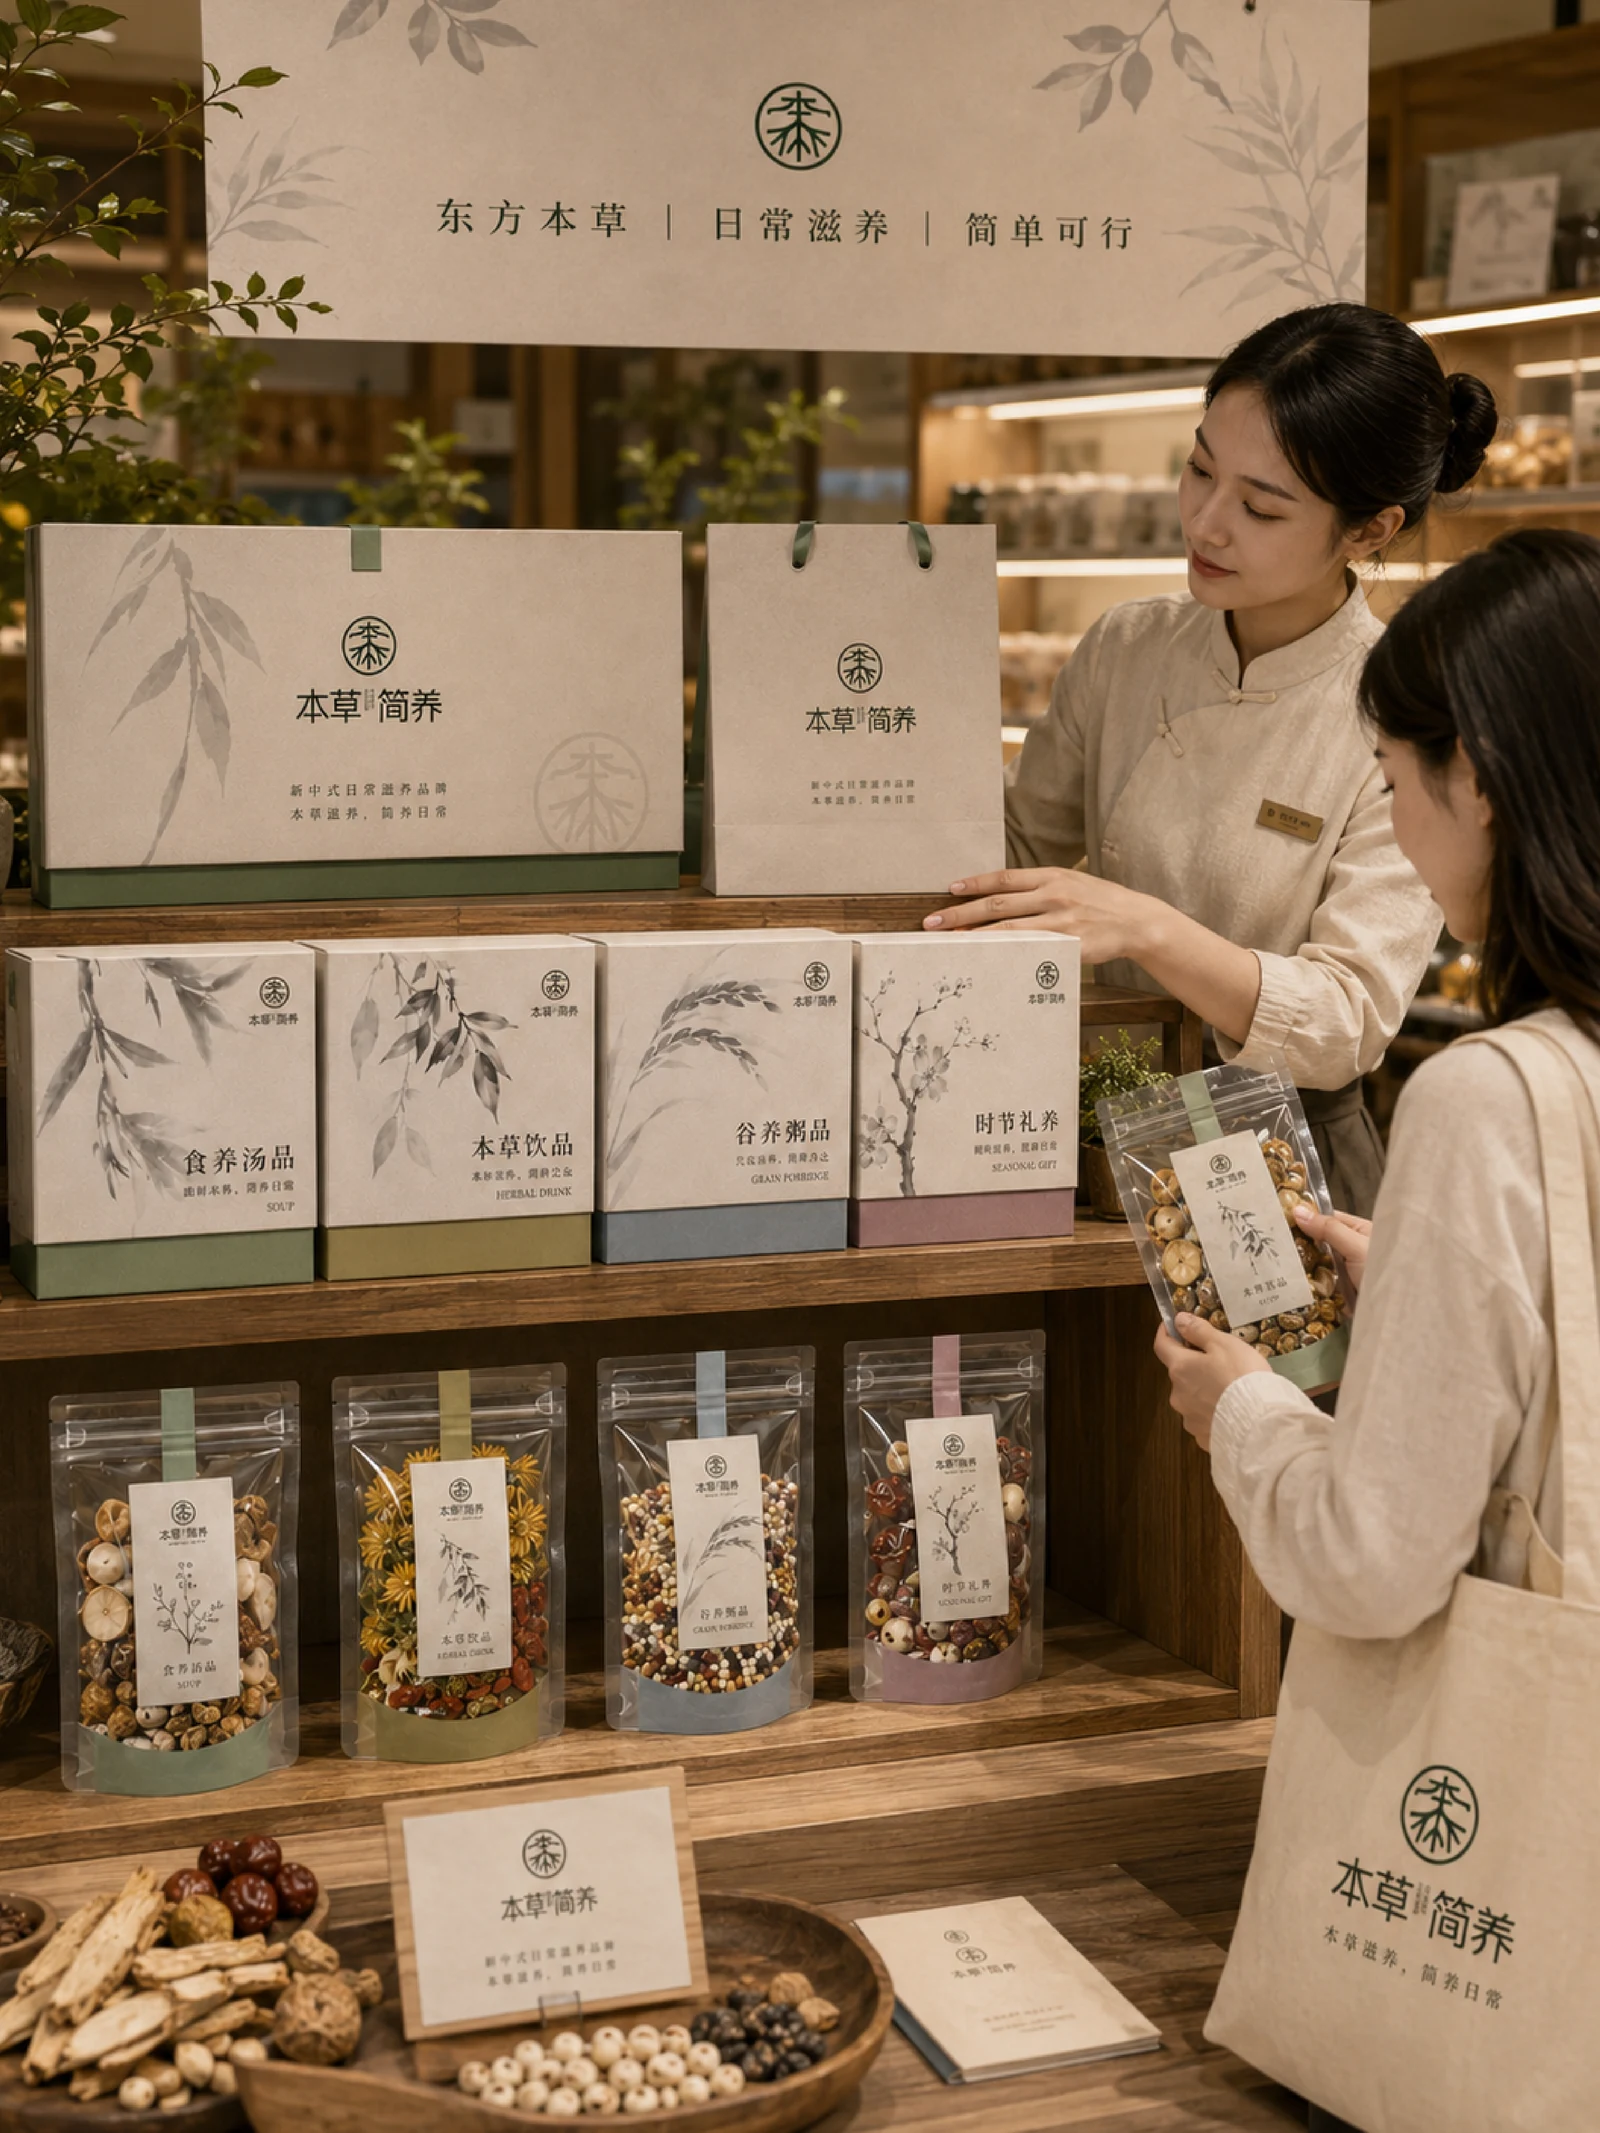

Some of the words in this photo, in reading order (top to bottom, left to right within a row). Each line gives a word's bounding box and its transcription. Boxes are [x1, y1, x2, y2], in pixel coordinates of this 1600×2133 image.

[436, 198, 628, 238] 东方本草
[714, 206, 889, 245] 日常滋养
[965, 212, 1133, 250] 简单可行
[295, 688, 443, 724] 本草简养
[805, 705, 917, 734] 本草简养
[735, 1118, 830, 1146] 谷养粥品
[975, 1109, 1060, 1135] 时节礼养
[183, 1144, 294, 1176] 食养汤品
[472, 1132, 573, 1160] 本草饮品
[266, 1201, 295, 1212] SOUP
[539, 1186, 573, 1198] DRINK
[501, 1886, 598, 1922] 本草简养
[1331, 1857, 1516, 1964] 本草简养
